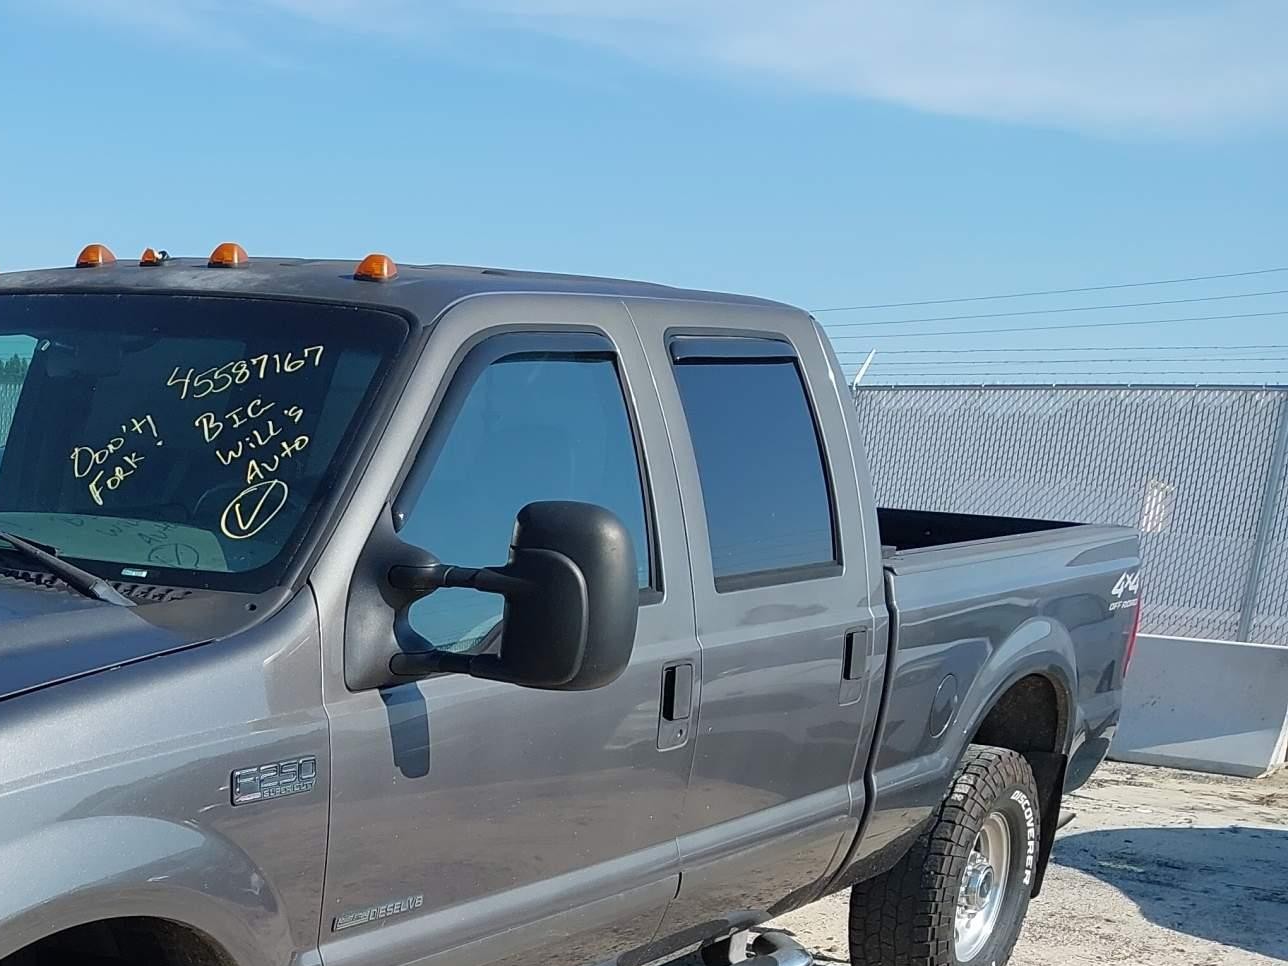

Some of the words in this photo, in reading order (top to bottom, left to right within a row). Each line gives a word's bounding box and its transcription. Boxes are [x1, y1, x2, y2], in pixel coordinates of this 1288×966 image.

[166, 345, 324, 400] 45587167
[1010, 790, 1035, 885] DISCOVERER
[369, 901, 408, 921] DIESEL
